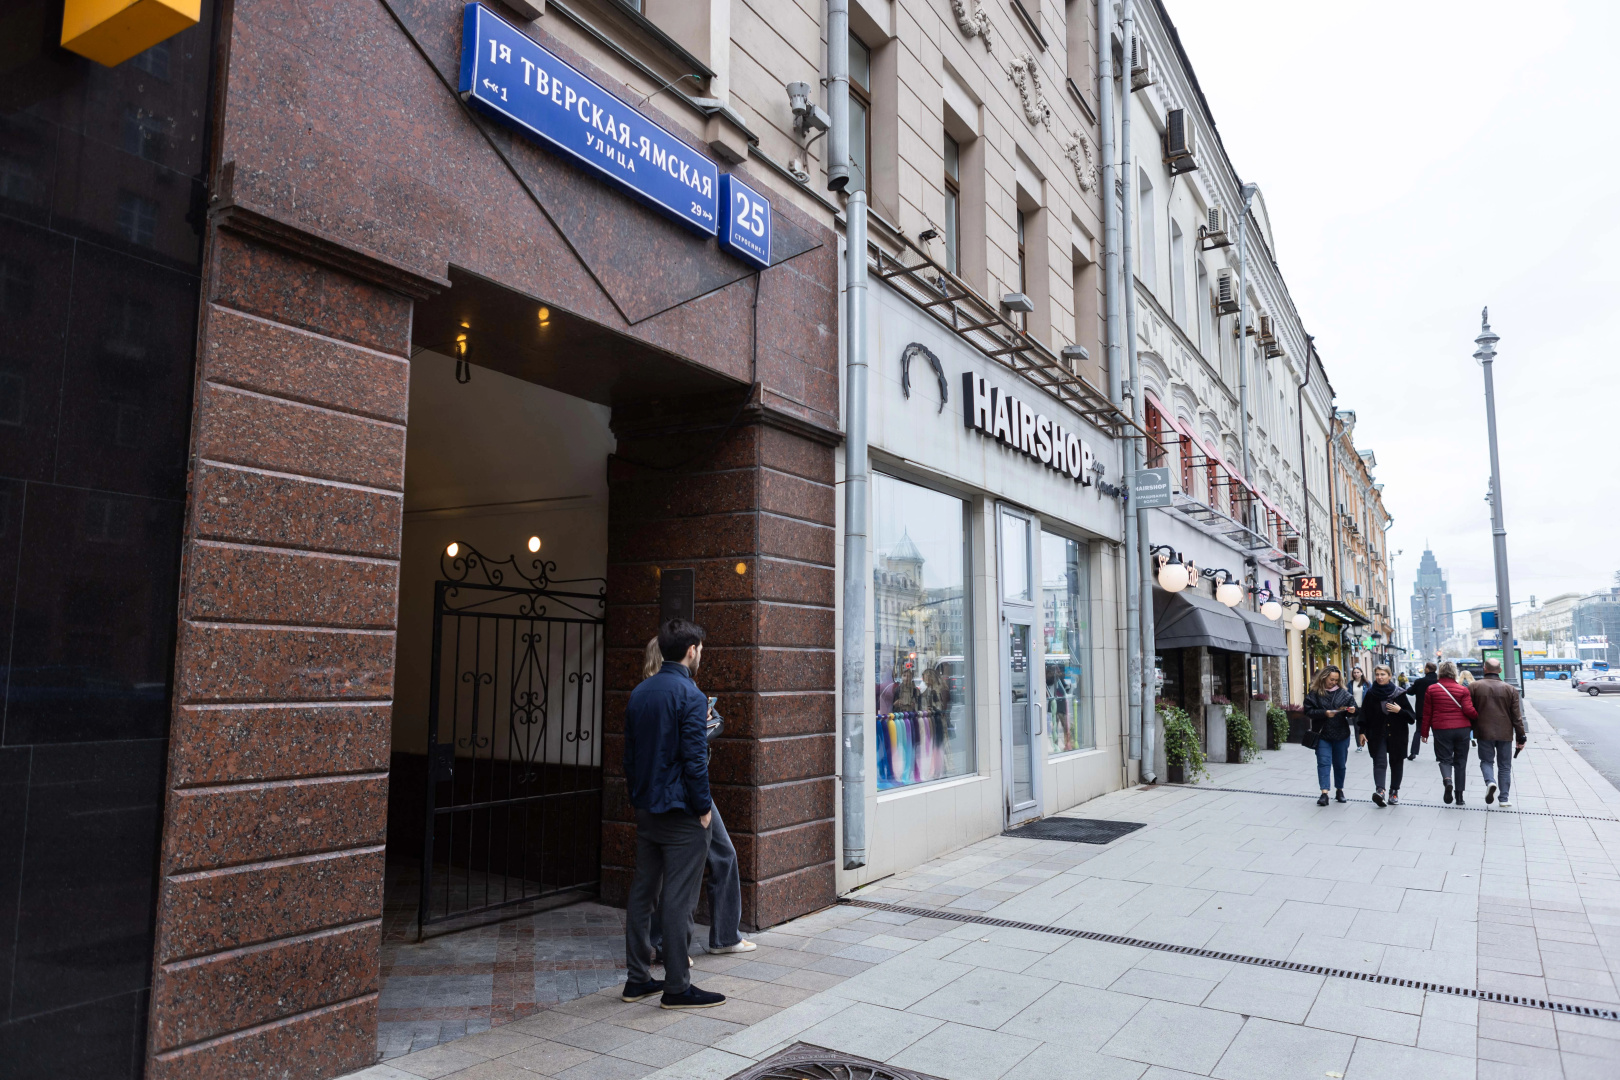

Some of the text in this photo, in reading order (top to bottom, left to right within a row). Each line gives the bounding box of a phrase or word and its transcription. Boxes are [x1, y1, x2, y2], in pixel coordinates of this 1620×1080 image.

[500, 88, 508, 102] 1
[520, 56, 712, 199] ТВЕРСКАЯ-ЯМСКАЯ
[586, 131, 636, 173] УЛИЦА
[691, 201, 702, 217] 29
[736, 192, 765, 238] 25
[734, 233, 762, 254] СТРОЕНИЕ
[963, 371, 1093, 487] HAIRSHOP
[1301, 578, 1317, 589] 24
